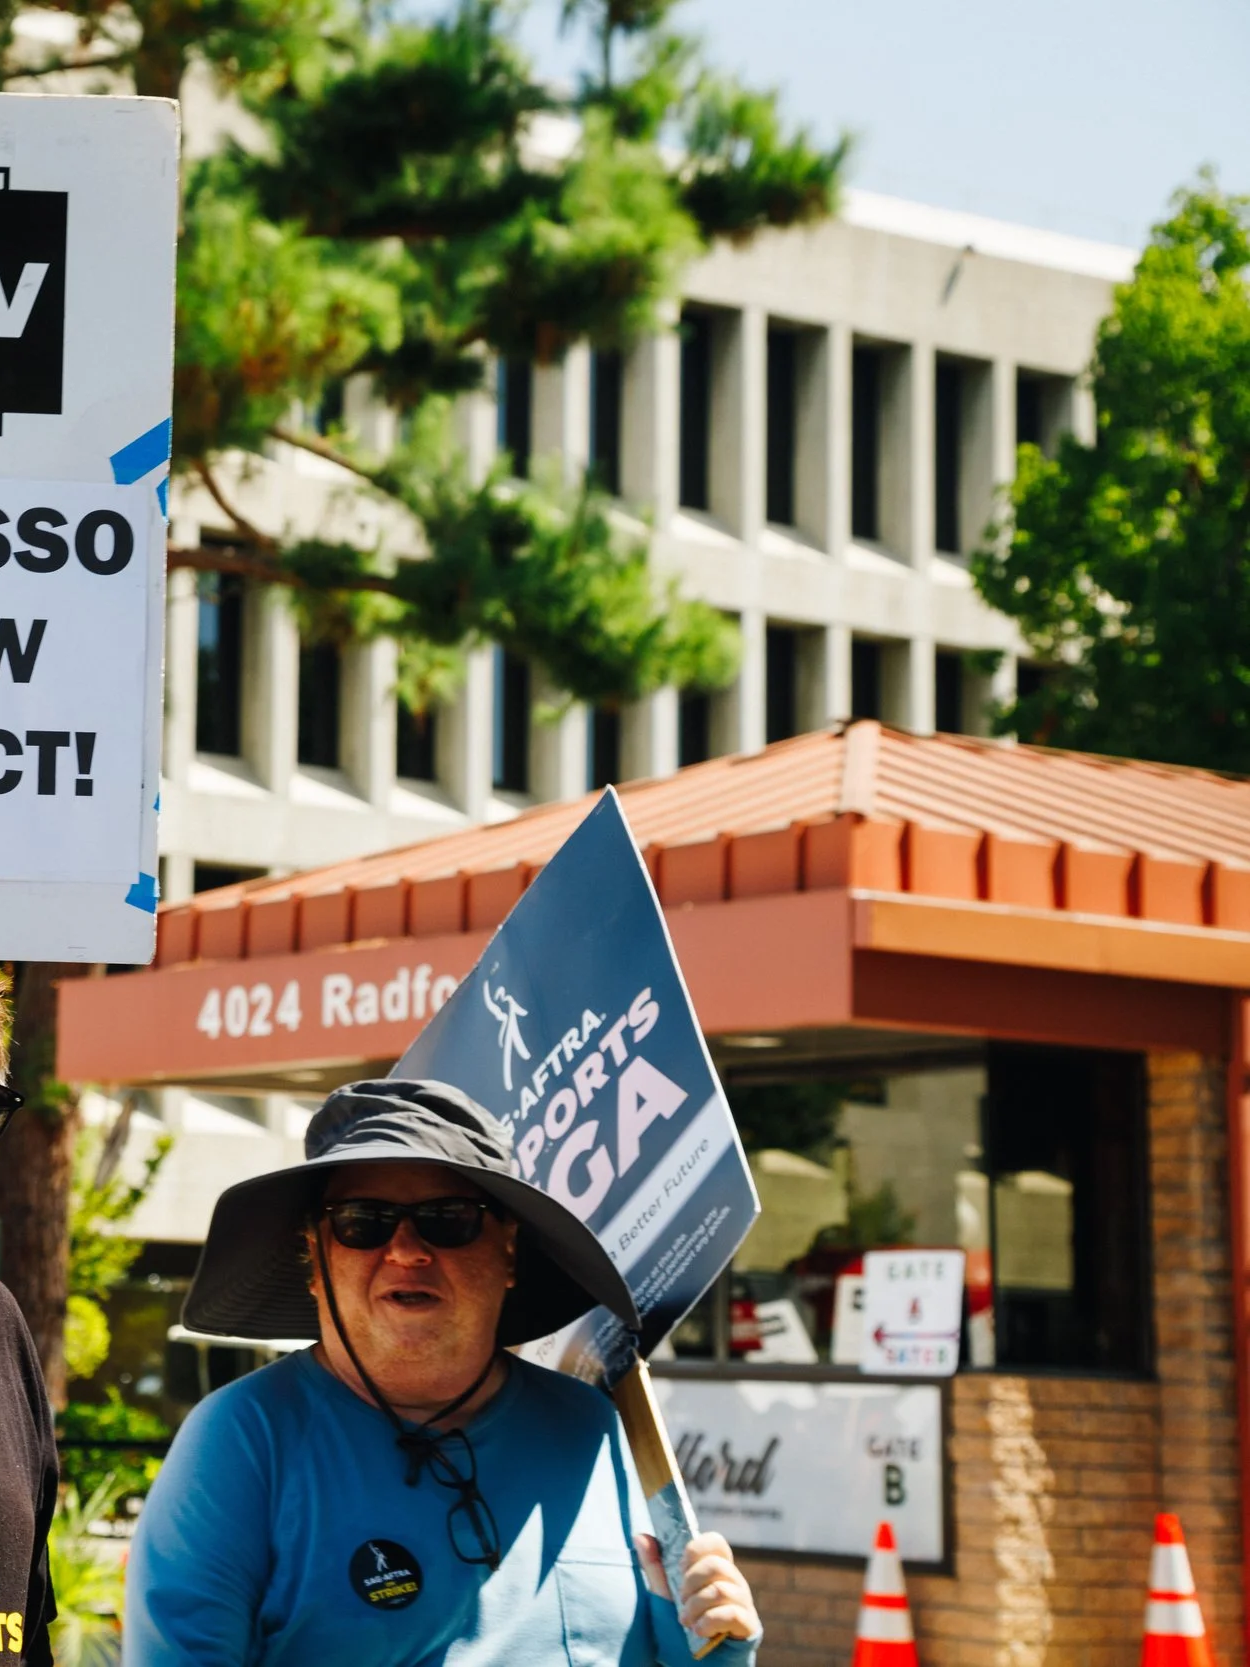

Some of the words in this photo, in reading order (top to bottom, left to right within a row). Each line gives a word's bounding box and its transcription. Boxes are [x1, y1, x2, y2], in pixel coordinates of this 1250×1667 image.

[196, 980, 302, 1040] 4024
[321, 963, 459, 1028] Radfo
[512, 987, 659, 1180] PORTS
[545, 1056, 689, 1222] GA
[618, 1195, 663, 1251] Better
[663, 1139, 709, 1197] Future
[866, 1434, 923, 1461] GATE
[884, 1464, 906, 1506] B
